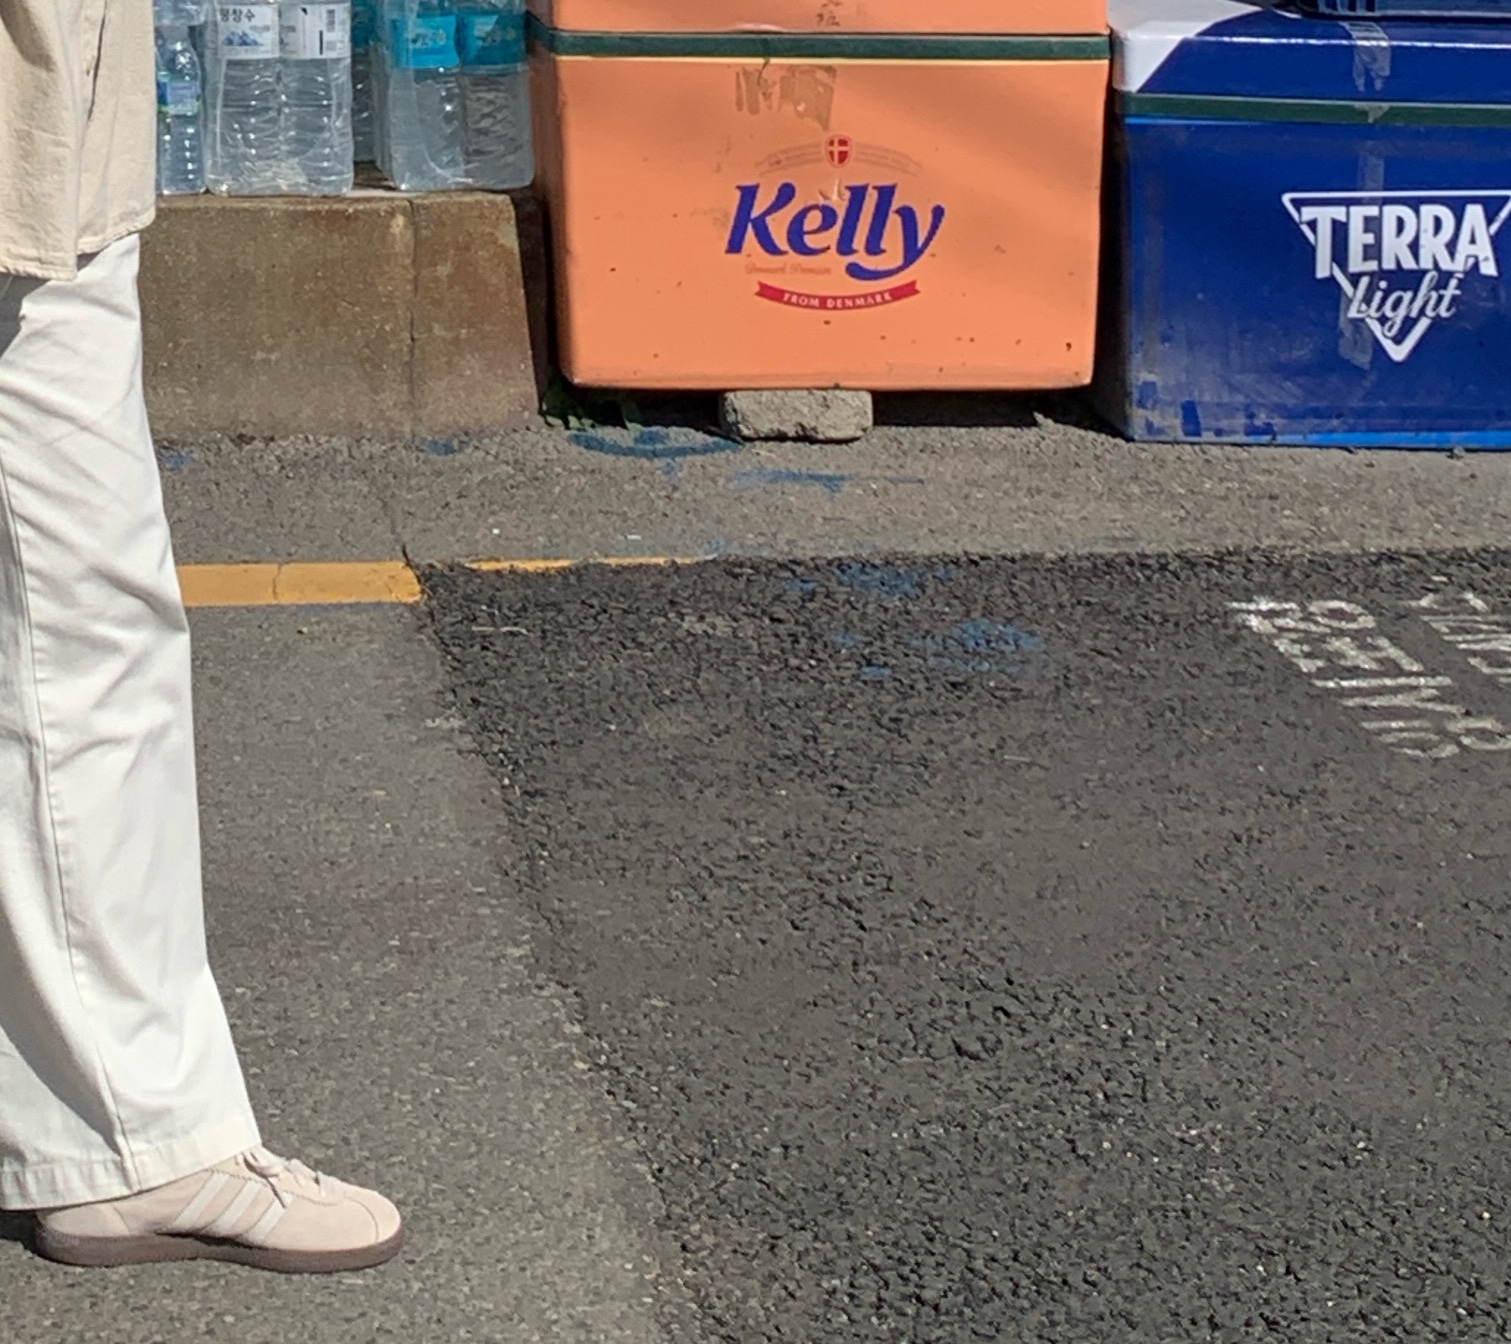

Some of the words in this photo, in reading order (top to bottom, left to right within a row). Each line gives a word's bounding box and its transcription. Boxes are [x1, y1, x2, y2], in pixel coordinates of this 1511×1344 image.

[724, 181, 946, 281] Kelly
[1301, 204, 1500, 280] TERRA
[784, 291, 822, 308] FROM
[825, 290, 894, 309] DENMARK
[1347, 270, 1462, 337] Light
